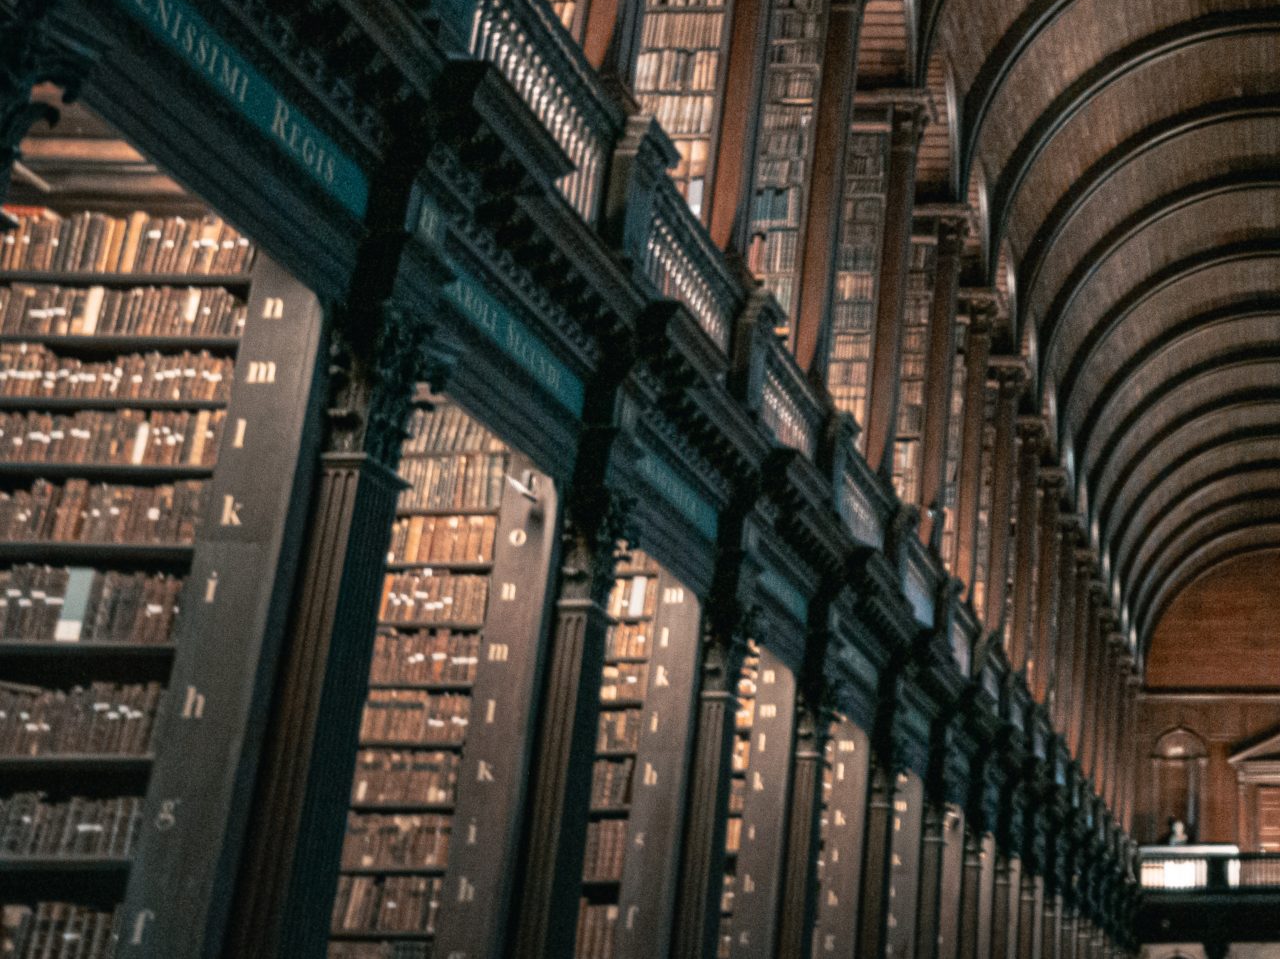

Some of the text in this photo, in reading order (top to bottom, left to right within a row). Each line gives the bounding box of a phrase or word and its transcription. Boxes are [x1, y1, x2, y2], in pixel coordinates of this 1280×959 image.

[271, 97, 336, 183] REGIS
[263, 298, 283, 319] n
[247, 361, 276, 384] m
[234, 418, 246, 448] l
[221, 495, 243, 526] k
[509, 529, 526, 546] o
[205, 571, 218, 603] i
[502, 582, 516, 601] n
[664, 588, 683, 604] m
[660, 627, 670, 648] l
[489, 643, 508, 661] m
[656, 665, 668, 686] k
[183, 685, 204, 718] h
[486, 699, 496, 723] l
[478, 760, 493, 781] k
[644, 762, 657, 786] h
[467, 817, 475, 844] i
[458, 876, 474, 902] h
[131, 909, 154, 945] f
